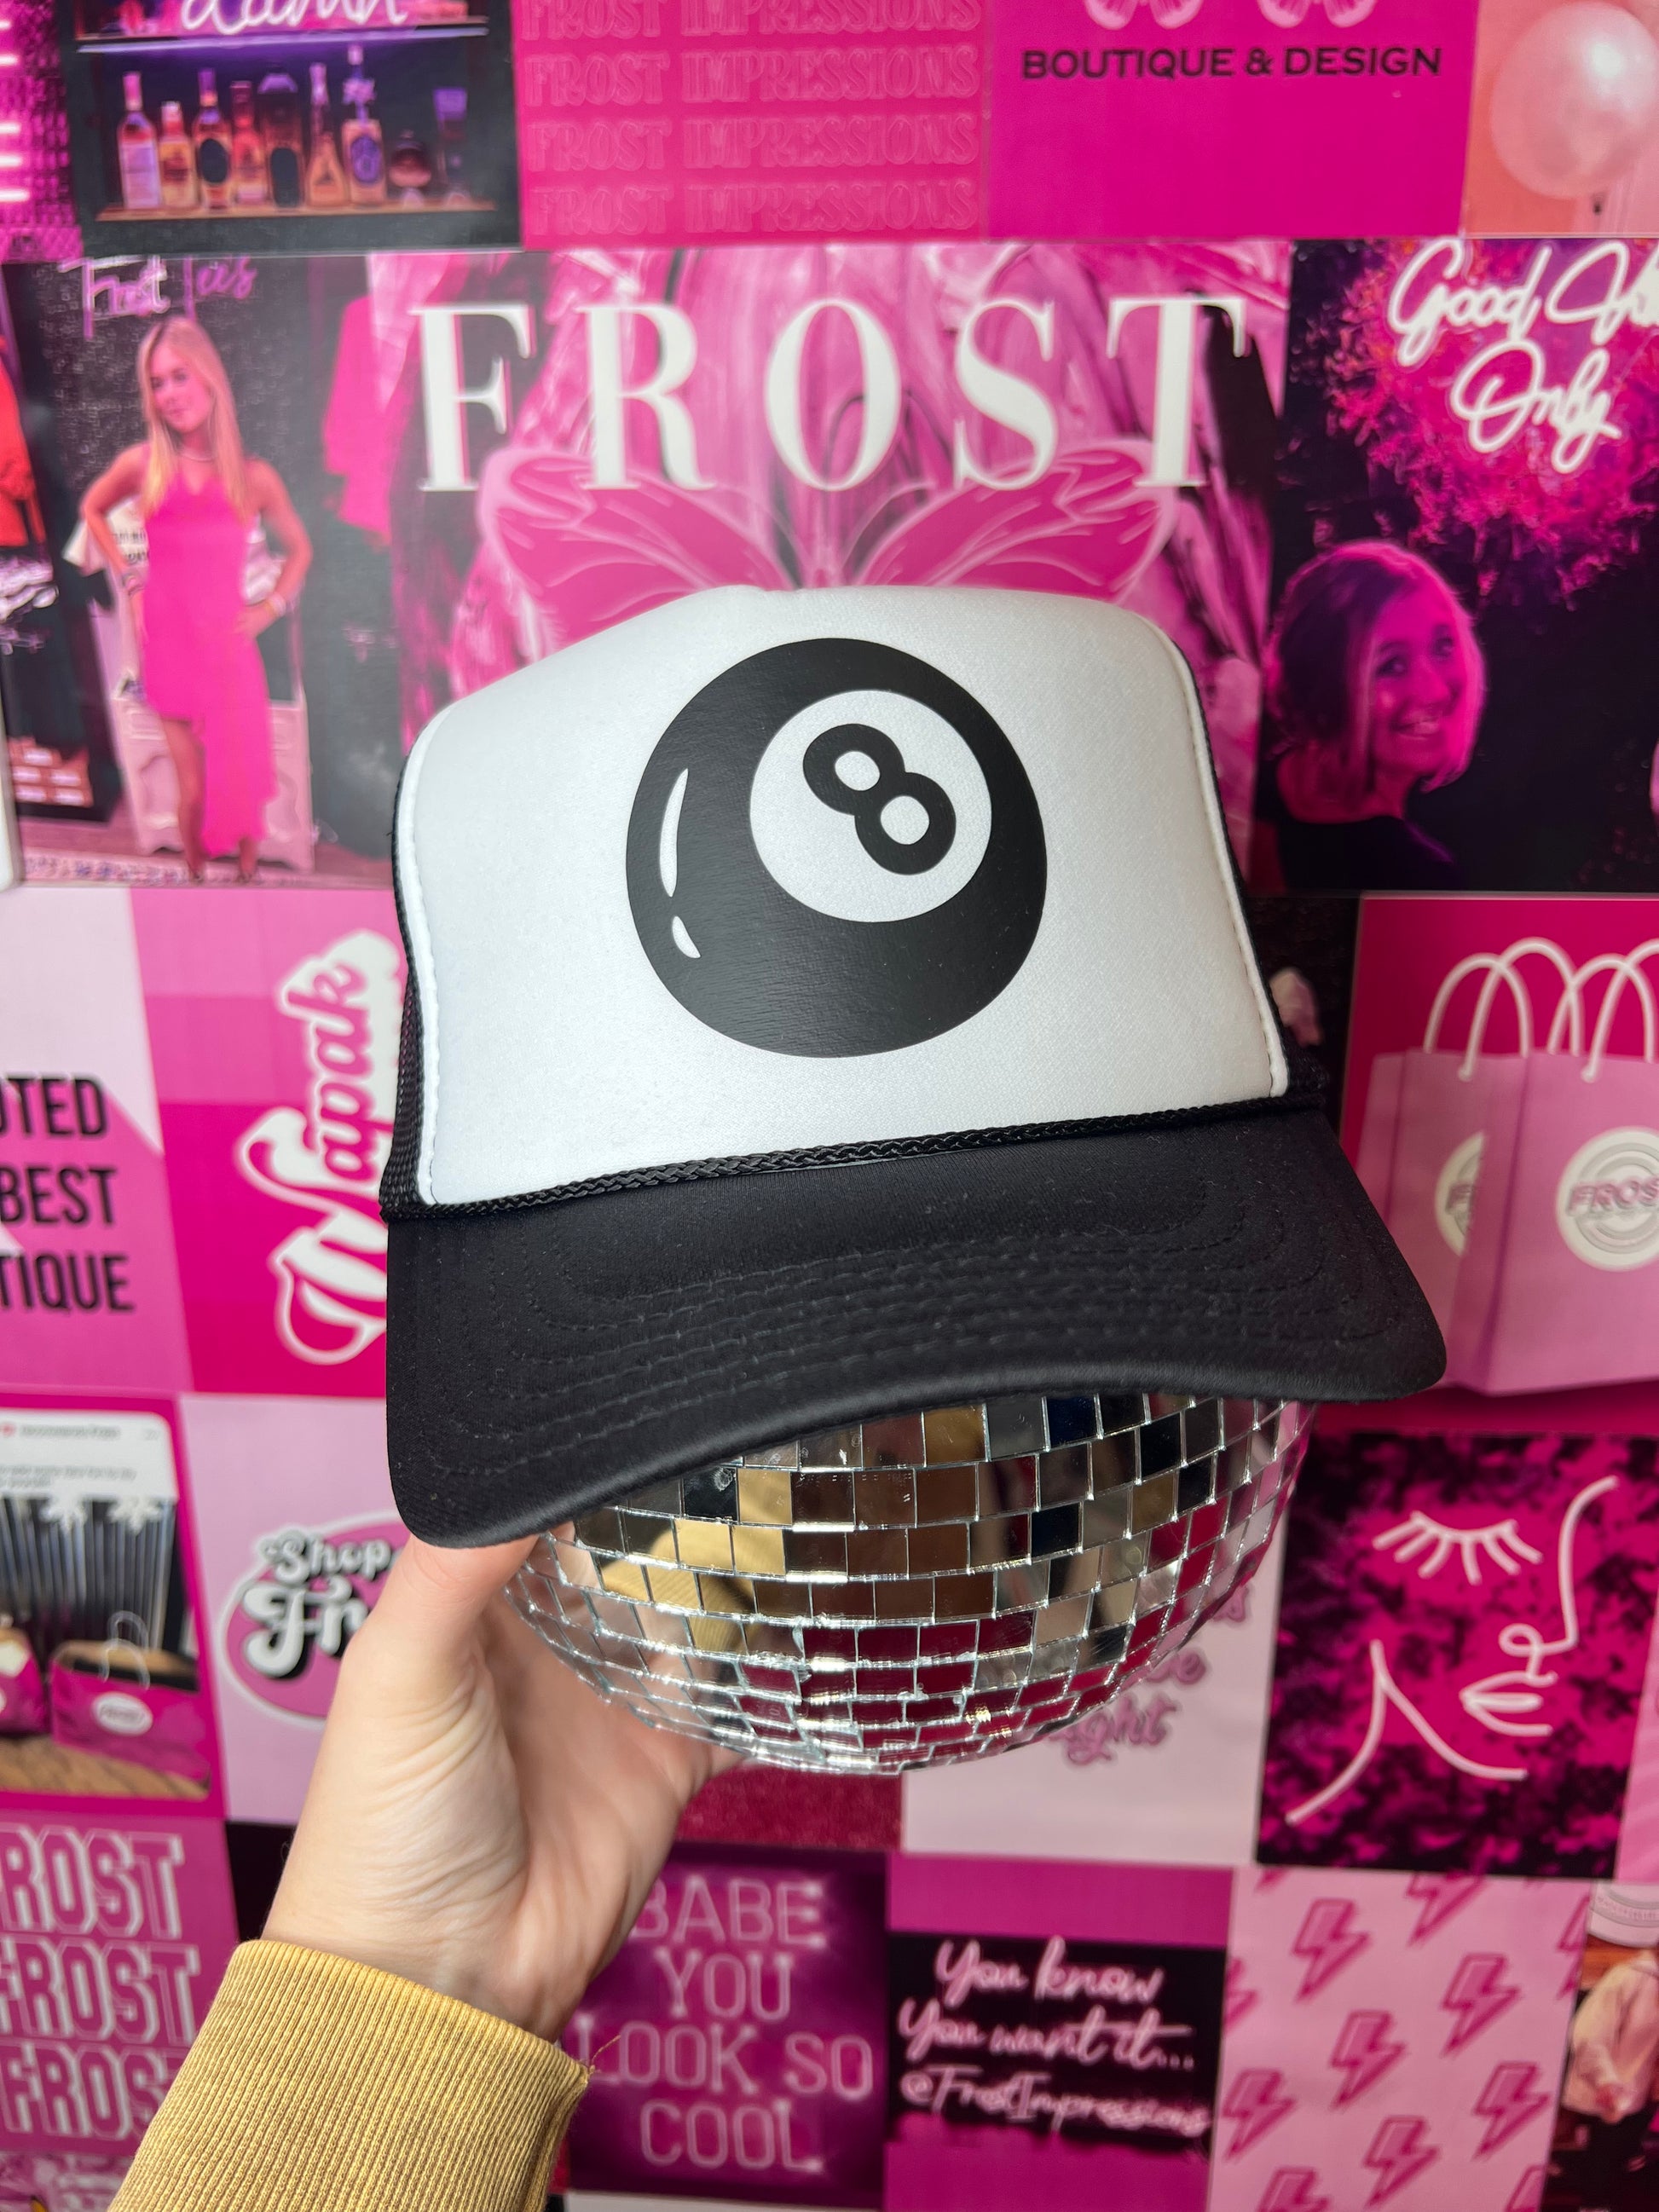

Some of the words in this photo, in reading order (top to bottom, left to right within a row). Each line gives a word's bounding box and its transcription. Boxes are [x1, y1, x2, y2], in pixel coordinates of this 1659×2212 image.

[523, 52, 670, 107] FROST
[681, 45, 980, 102] IMPRESSIONS
[1023, 49, 1234, 79] BOUTIQUE
[1245, 49, 1274, 76] &
[1285, 47, 1442, 75] DESIGN
[526, 120, 672, 170] FROST
[683, 113, 980, 168] IMPRESSIONS
[529, 184, 673, 235] FROST
[685, 179, 978, 232] IMPRESSIONS
[1388, 237, 1552, 367] Good
[409, 298, 1246, 492] FROST
[1450, 338, 1621, 474] Only
[803, 723, 957, 875] 8
[0, 1076, 107, 1138] TED
[257, 1530, 392, 1587] Shop
[0, 1822, 185, 1941] ROST
[629, 1876, 827, 1950] BABE
[653, 1947, 795, 2021] YOU
[934, 1938, 1028, 2008] You
[1033, 1934, 1165, 2004] know
[576, 2013, 759, 2094] LOOK
[783, 2032, 874, 2100] SO
[898, 1997, 986, 2062] You
[0, 2039, 186, 2141] FROS
[640, 2099, 825, 2173] COOL
